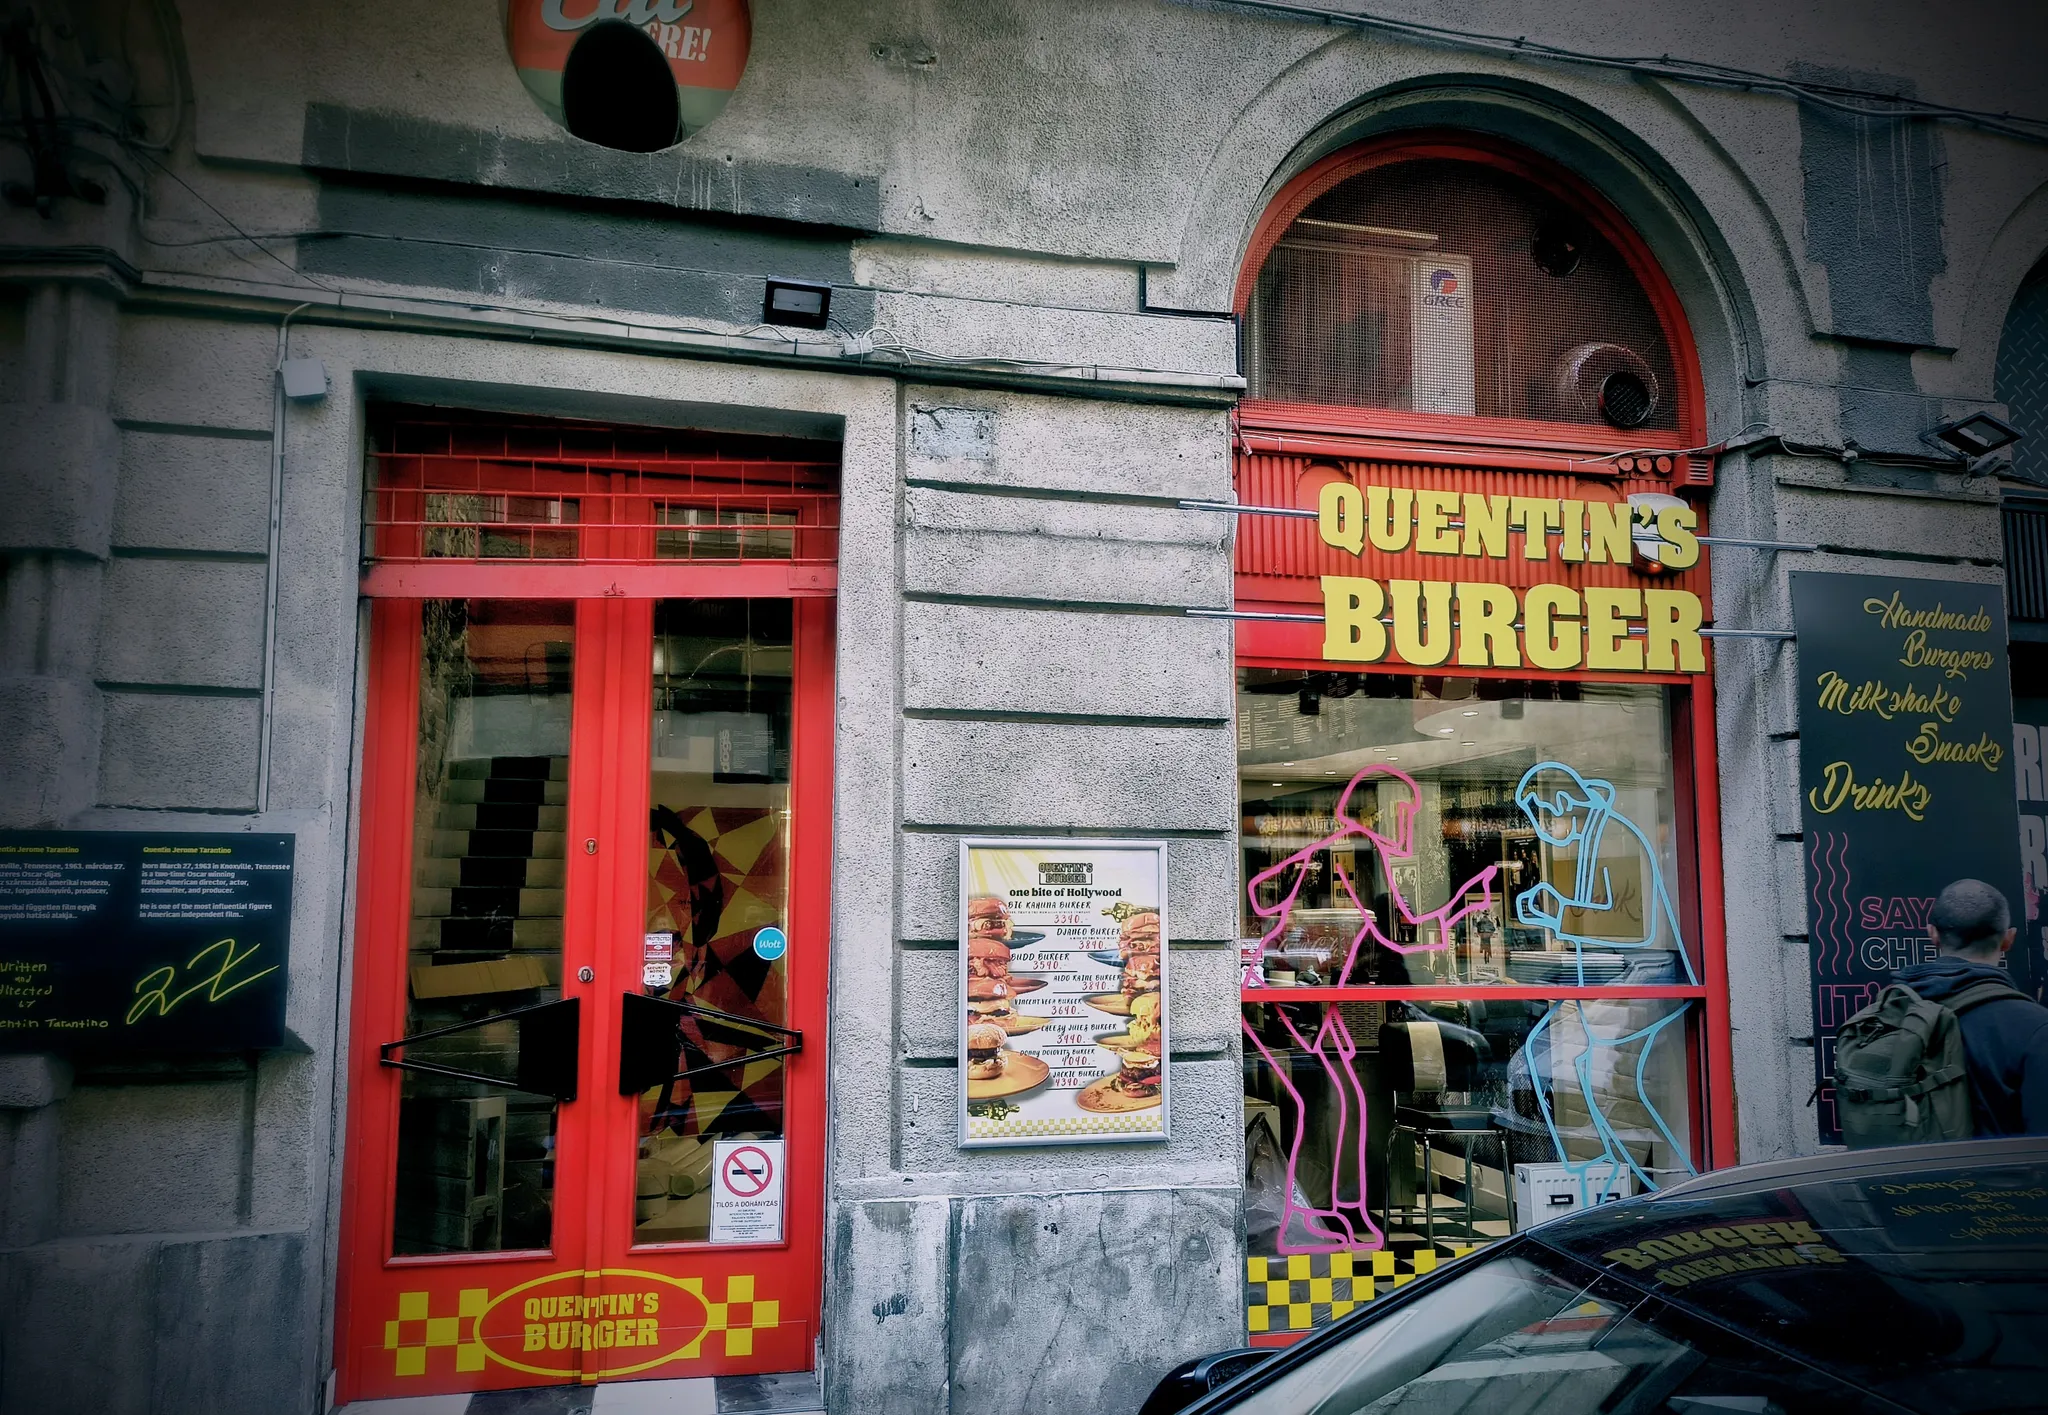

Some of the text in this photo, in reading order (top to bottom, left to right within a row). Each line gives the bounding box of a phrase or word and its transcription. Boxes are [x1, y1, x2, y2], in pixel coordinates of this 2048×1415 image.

[642, 22, 712, 62] RE!
[1424, 296, 1466, 308] GREE
[1318, 481, 1700, 569] QUENTIN'S
[1320, 575, 1706, 672] BURGER
[1863, 590, 1992, 632] Handmade
[1899, 629, 1994, 682] Burgers
[1817, 670, 1961, 722] Milkshake
[1906, 722, 2004, 772] Snacks
[1809, 761, 1931, 821] Drinks
[1038, 862, 1093, 873] QUENTIN'S
[1046, 874, 1086, 883] BURGER
[1032, 888, 1052, 896] bite
[1054, 888, 1065, 896] of
[1067, 888, 1122, 898] Hollywood
[1860, 896, 1937, 930] SAY
[760, 940, 781, 949] Wolt
[14, 975, 32, 984] and
[44, 1018, 109, 1028] Tarantino
[524, 1292, 660, 1320] QUENTIN'S
[523, 1318, 660, 1352] BURGER
